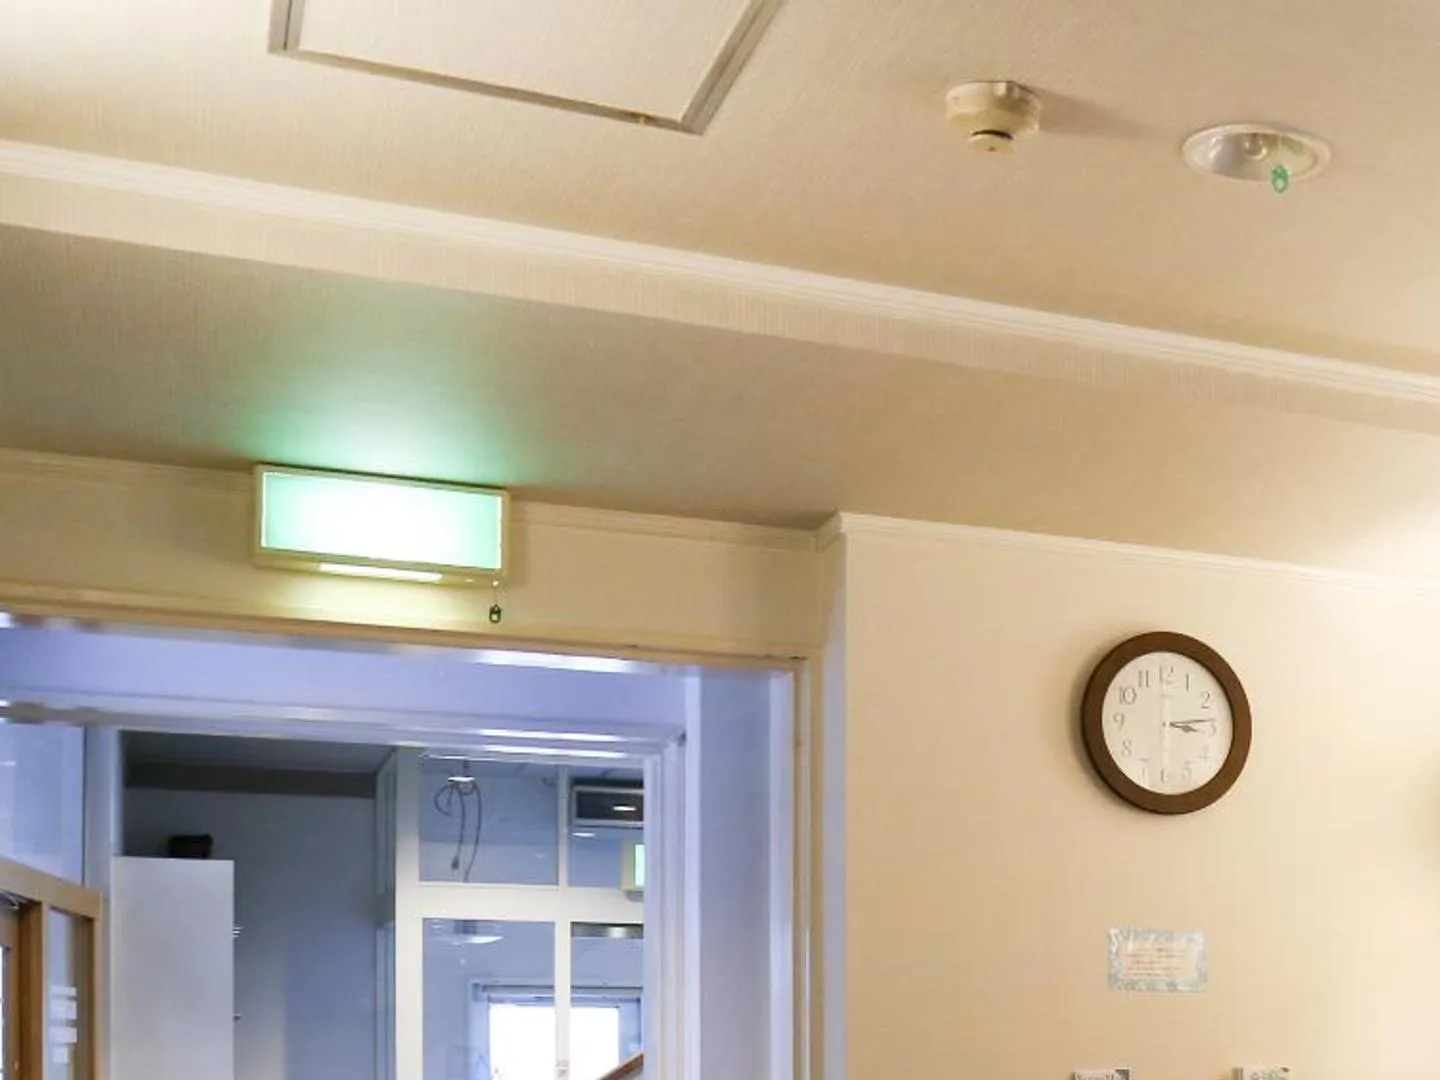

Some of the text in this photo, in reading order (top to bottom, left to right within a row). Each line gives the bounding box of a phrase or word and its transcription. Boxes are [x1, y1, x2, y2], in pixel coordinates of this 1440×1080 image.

[1138, 669, 1150, 688] 11
[1158, 666, 1174, 684] 12
[1119, 686, 1137, 705] 10
[1200, 691, 1211, 709] 2
[1113, 712, 1124, 730] 9
[1121, 740, 1132, 757] 8
